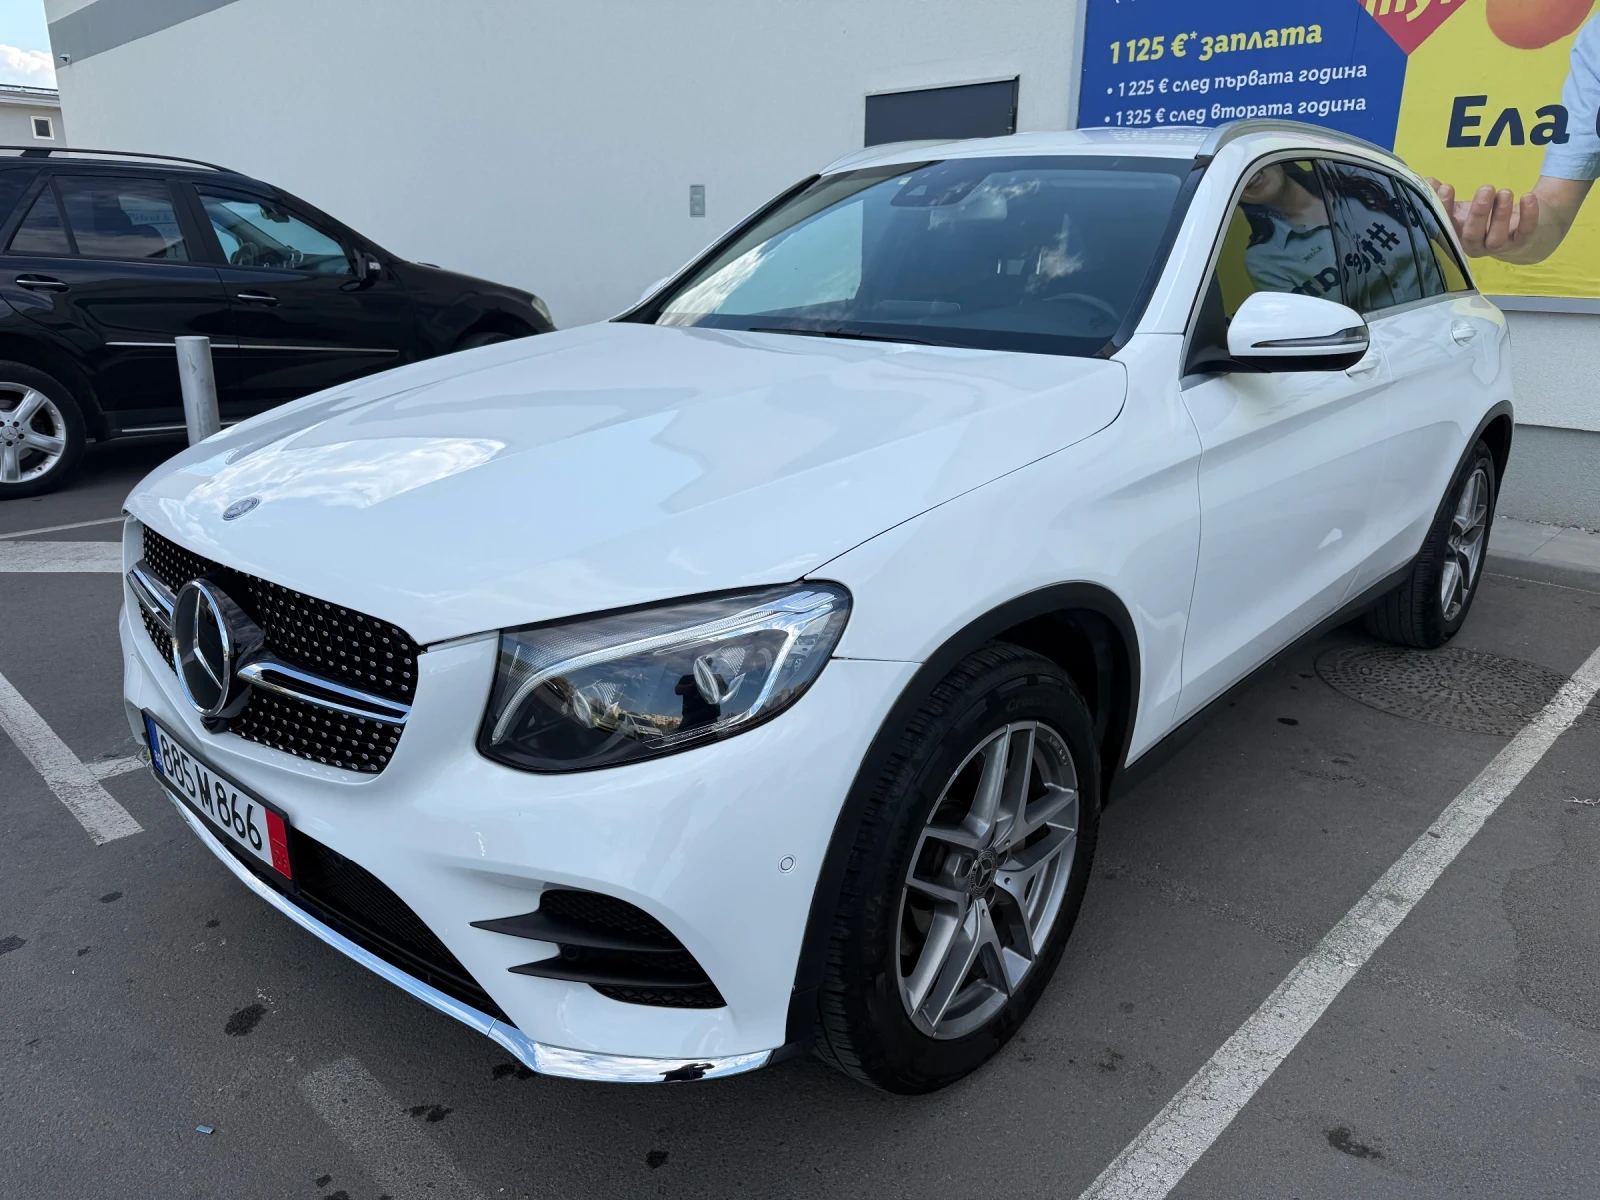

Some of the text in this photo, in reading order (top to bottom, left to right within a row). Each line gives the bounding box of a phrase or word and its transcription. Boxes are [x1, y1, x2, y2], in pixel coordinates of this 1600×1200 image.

[1198, 24, 1323, 62] заплата
[1158, 77, 1169, 94] €
[1172, 77, 1211, 95] след
[1214, 69, 1294, 92] първата
[1298, 64, 1368, 85] година
[1155, 107, 1166, 123] €
[1169, 107, 1207, 125] след
[1211, 103, 1293, 119] втората
[1297, 97, 1367, 117] година
[1446, 94, 1570, 148] Ела
